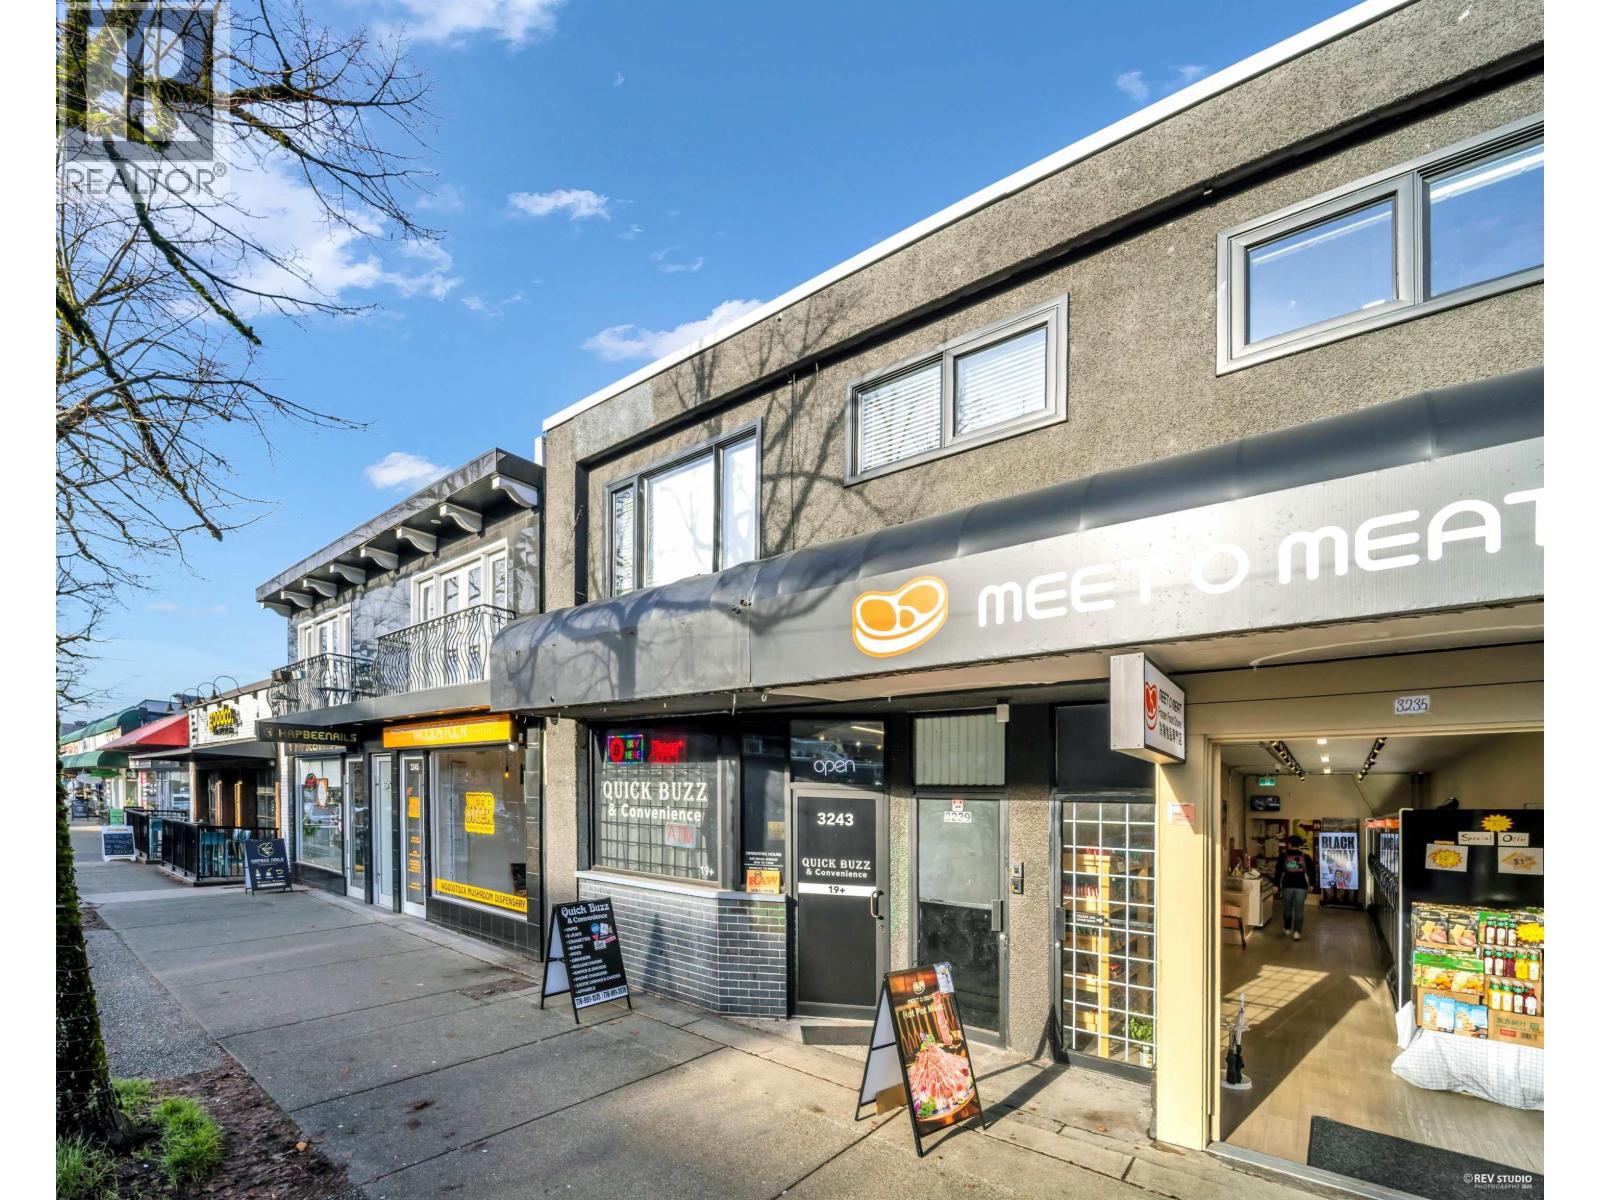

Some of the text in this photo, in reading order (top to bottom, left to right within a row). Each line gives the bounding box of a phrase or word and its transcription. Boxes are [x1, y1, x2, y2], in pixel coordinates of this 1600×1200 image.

[977, 556, 1168, 628] MEET
[1191, 544, 1250, 594] O
[1396, 698, 1428, 713] 3235
[813, 759, 856, 776] open
[602, 780, 709, 802] QUICK BUZZ
[608, 803, 702, 822] & Convenience
[816, 812, 854, 826] 3243
[945, 812, 971, 822] 3239
[667, 823, 695, 844] ATM
[1321, 836, 1355, 849] BLACK
[802, 857, 872, 870] QUICK BUZZ
[700, 866, 715, 876] 19+
[806, 868, 868, 878] & Convenience
[828, 886, 846, 894] 19+
[561, 902, 610, 918] Quick Buzz
